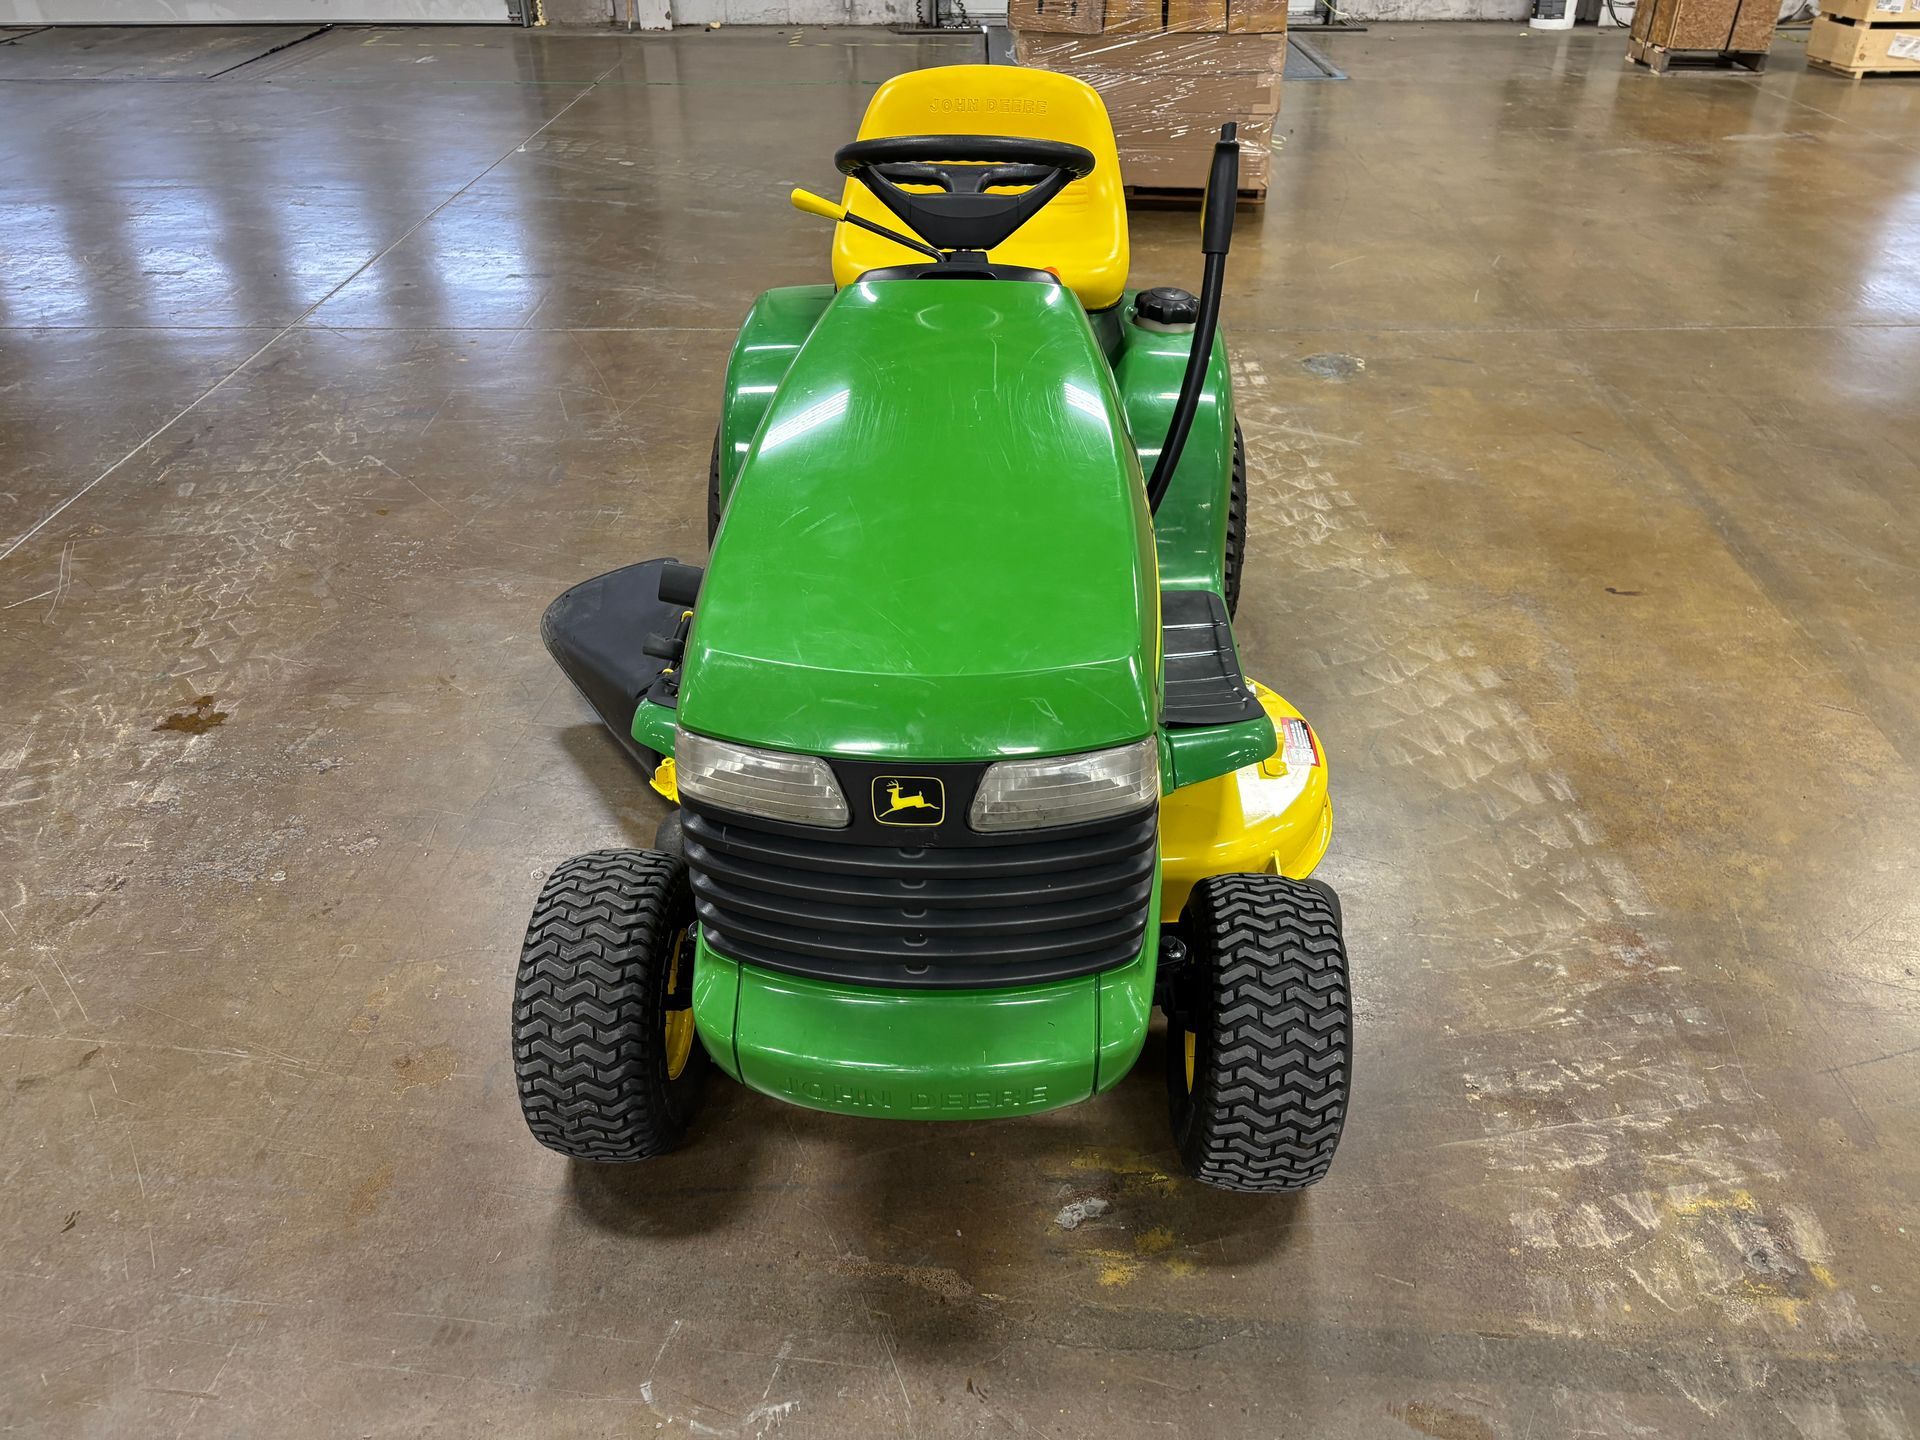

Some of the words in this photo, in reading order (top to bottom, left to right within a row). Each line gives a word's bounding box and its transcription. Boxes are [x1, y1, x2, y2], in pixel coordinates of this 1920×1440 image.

[929, 97, 979, 113] JOHN
[986, 97, 1048, 115] DEERE
[781, 1077, 892, 1109] JOHN
[909, 1086, 1048, 1110] DEERE
